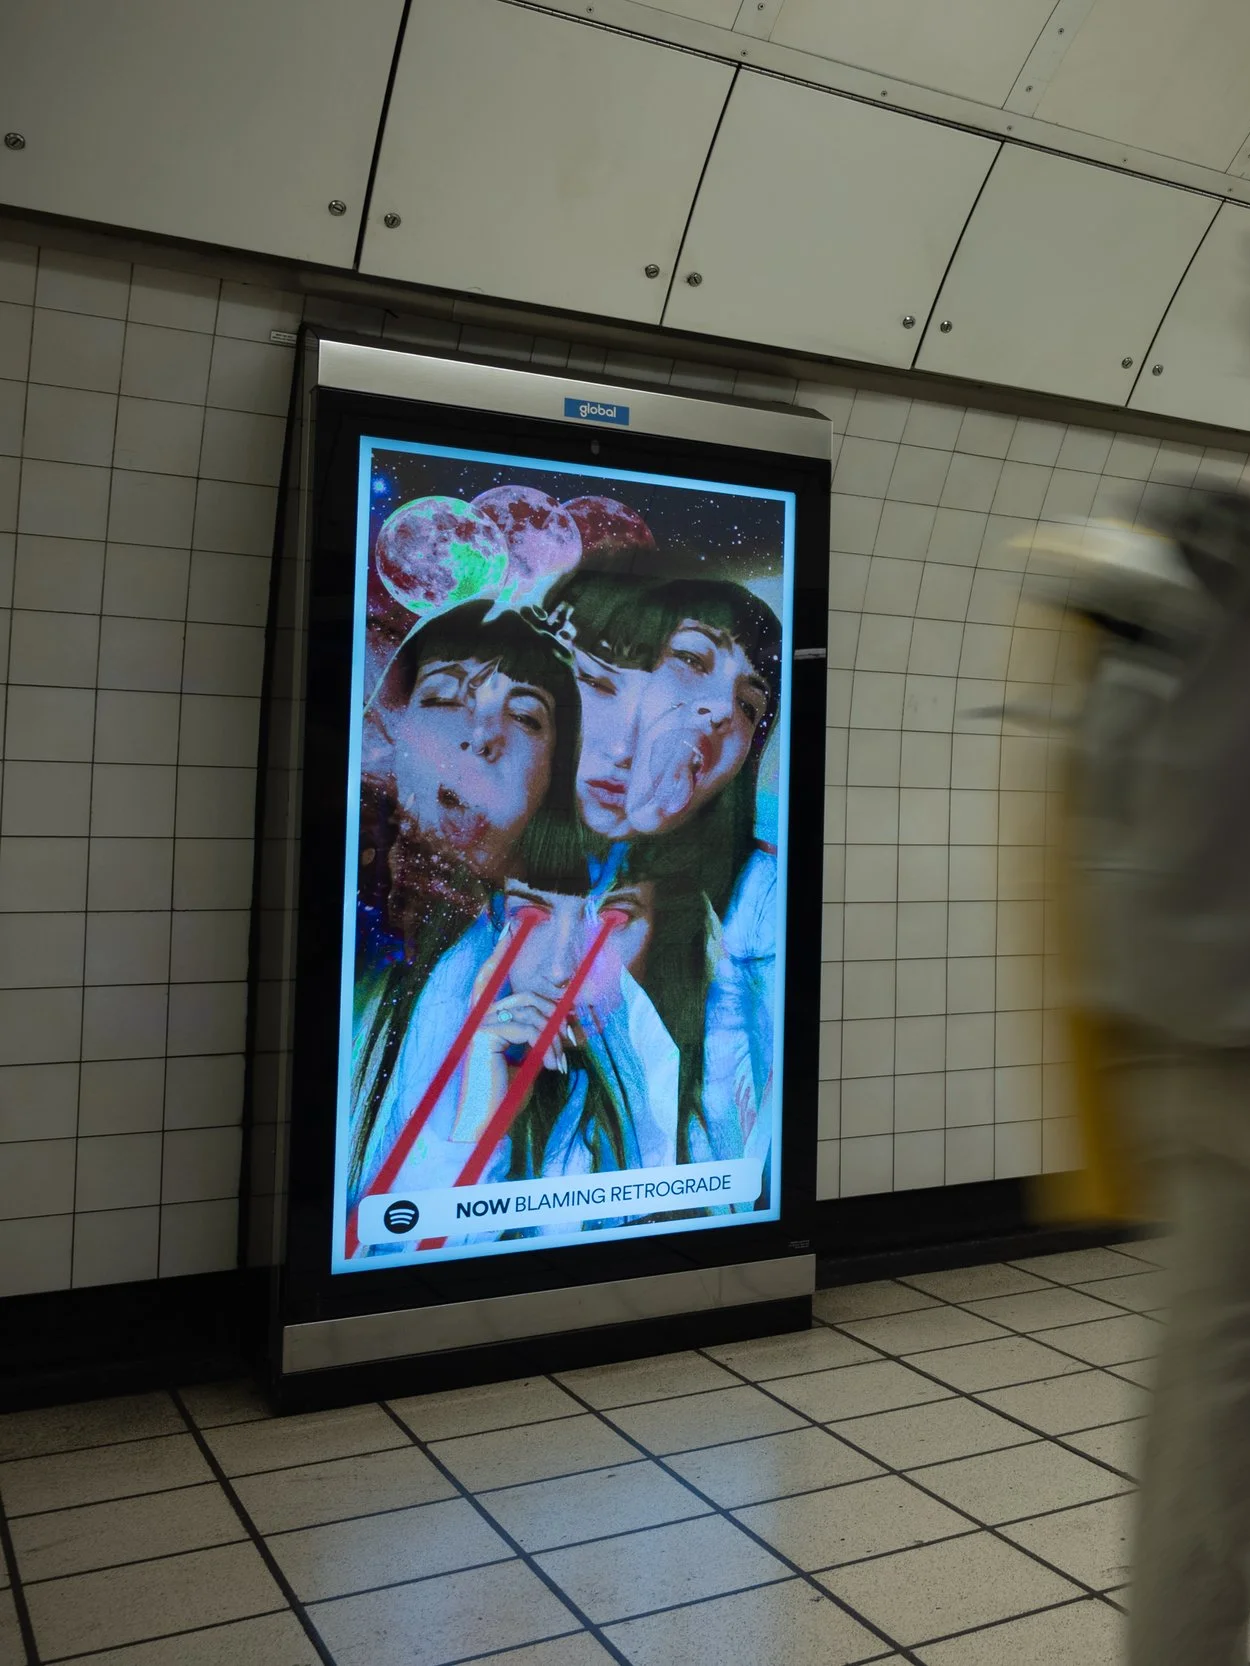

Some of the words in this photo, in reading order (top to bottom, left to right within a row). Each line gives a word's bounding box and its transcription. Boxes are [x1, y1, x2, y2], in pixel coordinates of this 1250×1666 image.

[579, 403, 617, 418] global
[456, 1197, 511, 1219] NOW
[515, 1187, 606, 1213] BLAMING
[611, 1174, 732, 1202] RETROGRADE
